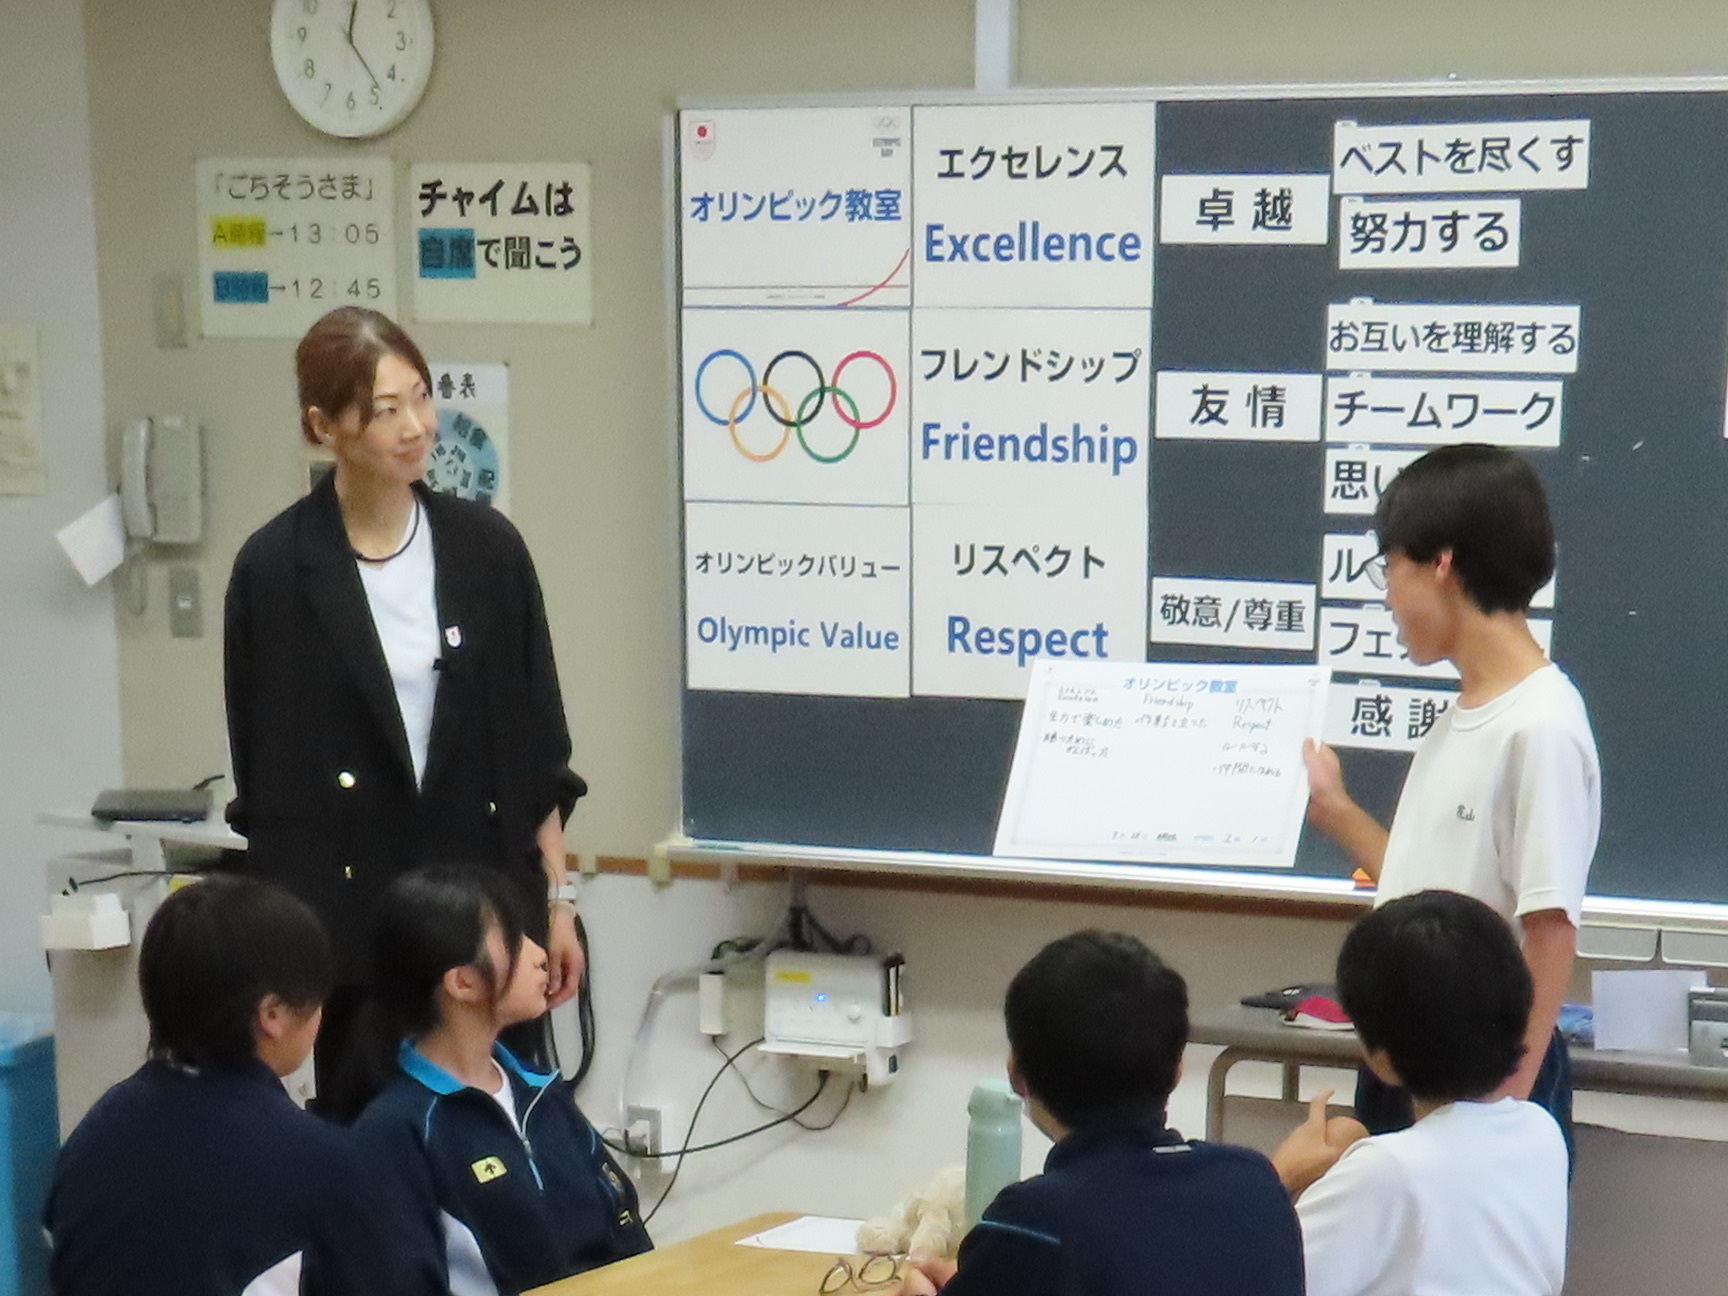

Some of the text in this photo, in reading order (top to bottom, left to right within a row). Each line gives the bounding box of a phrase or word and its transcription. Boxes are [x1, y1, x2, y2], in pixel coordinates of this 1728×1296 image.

[936, 144, 1130, 180] エクセレンス
[1339, 136, 1585, 175] ベストを尽くす
[418, 178, 575, 218] チャイムは
[690, 188, 903, 224] オリンピック教室
[1196, 187, 1294, 233] 卓越
[924, 222, 1142, 264] Excellence
[1349, 210, 1511, 256] 努力する
[1330, 320, 1578, 357] お互いを理解する
[921, 347, 1143, 384] フレンドシップ
[1191, 384, 1287, 429] 友情
[1333, 392, 1558, 430] チームワーク
[921, 422, 1139, 474] Friendship
[694, 551, 901, 578] オリンピックバリュー
[953, 543, 1106, 577] リスペクト
[1160, 593, 1306, 636] 敬意/尊重
[697, 617, 900, 652] Olympic Value
[947, 615, 1108, 666] Respect
[1330, 621, 1409, 660] フェ
[1123, 677, 1238, 694] オリンピック教室
